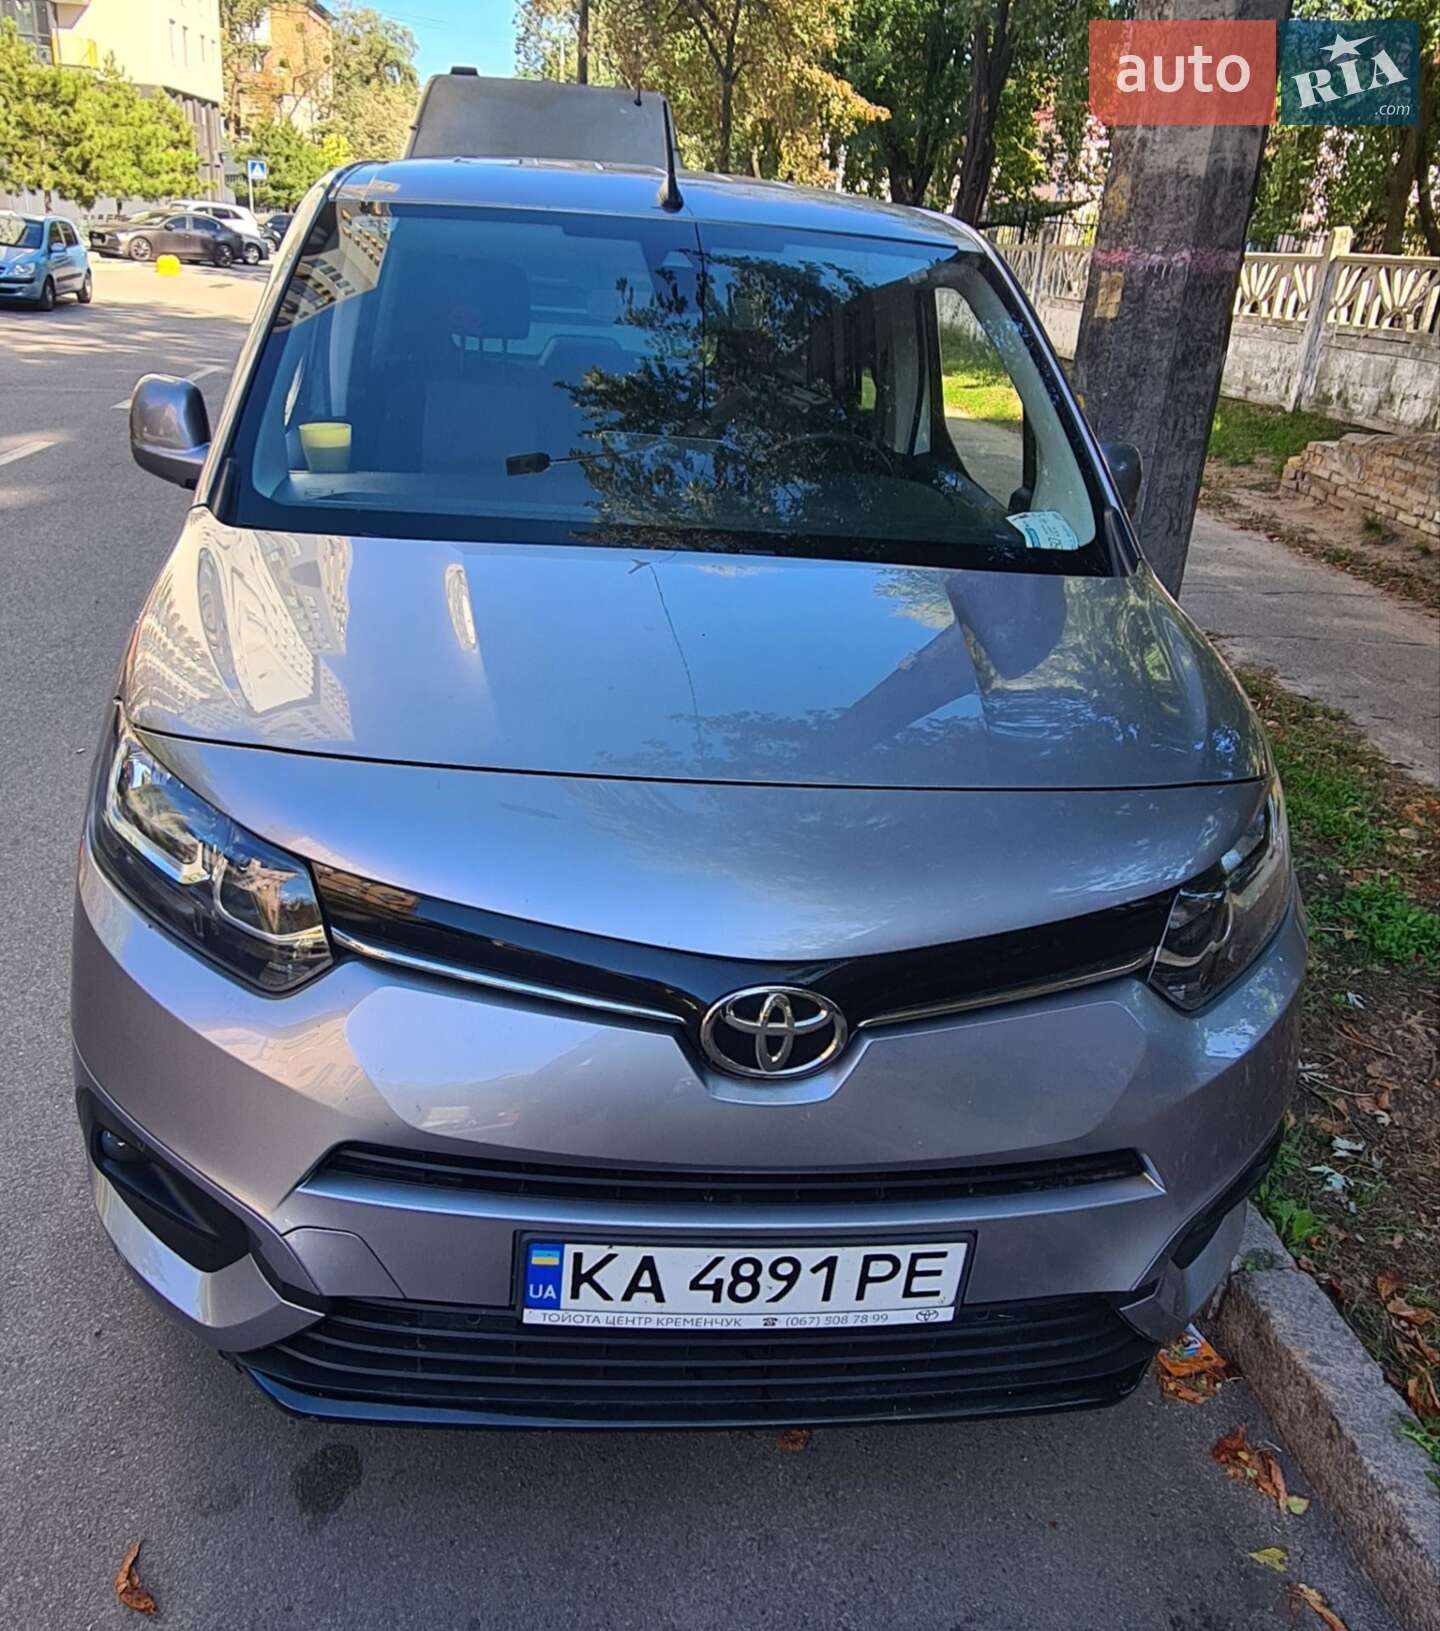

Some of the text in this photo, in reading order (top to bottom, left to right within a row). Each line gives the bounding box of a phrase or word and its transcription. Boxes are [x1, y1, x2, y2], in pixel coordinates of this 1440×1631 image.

[570, 1251, 948, 1303] KA 4891 PE
[529, 1283, 557, 1299] UA
[541, 1312, 889, 1328] ТОЙОТА ЦЕНТР КРЕМЕНЧУК (067) 508 78 99
